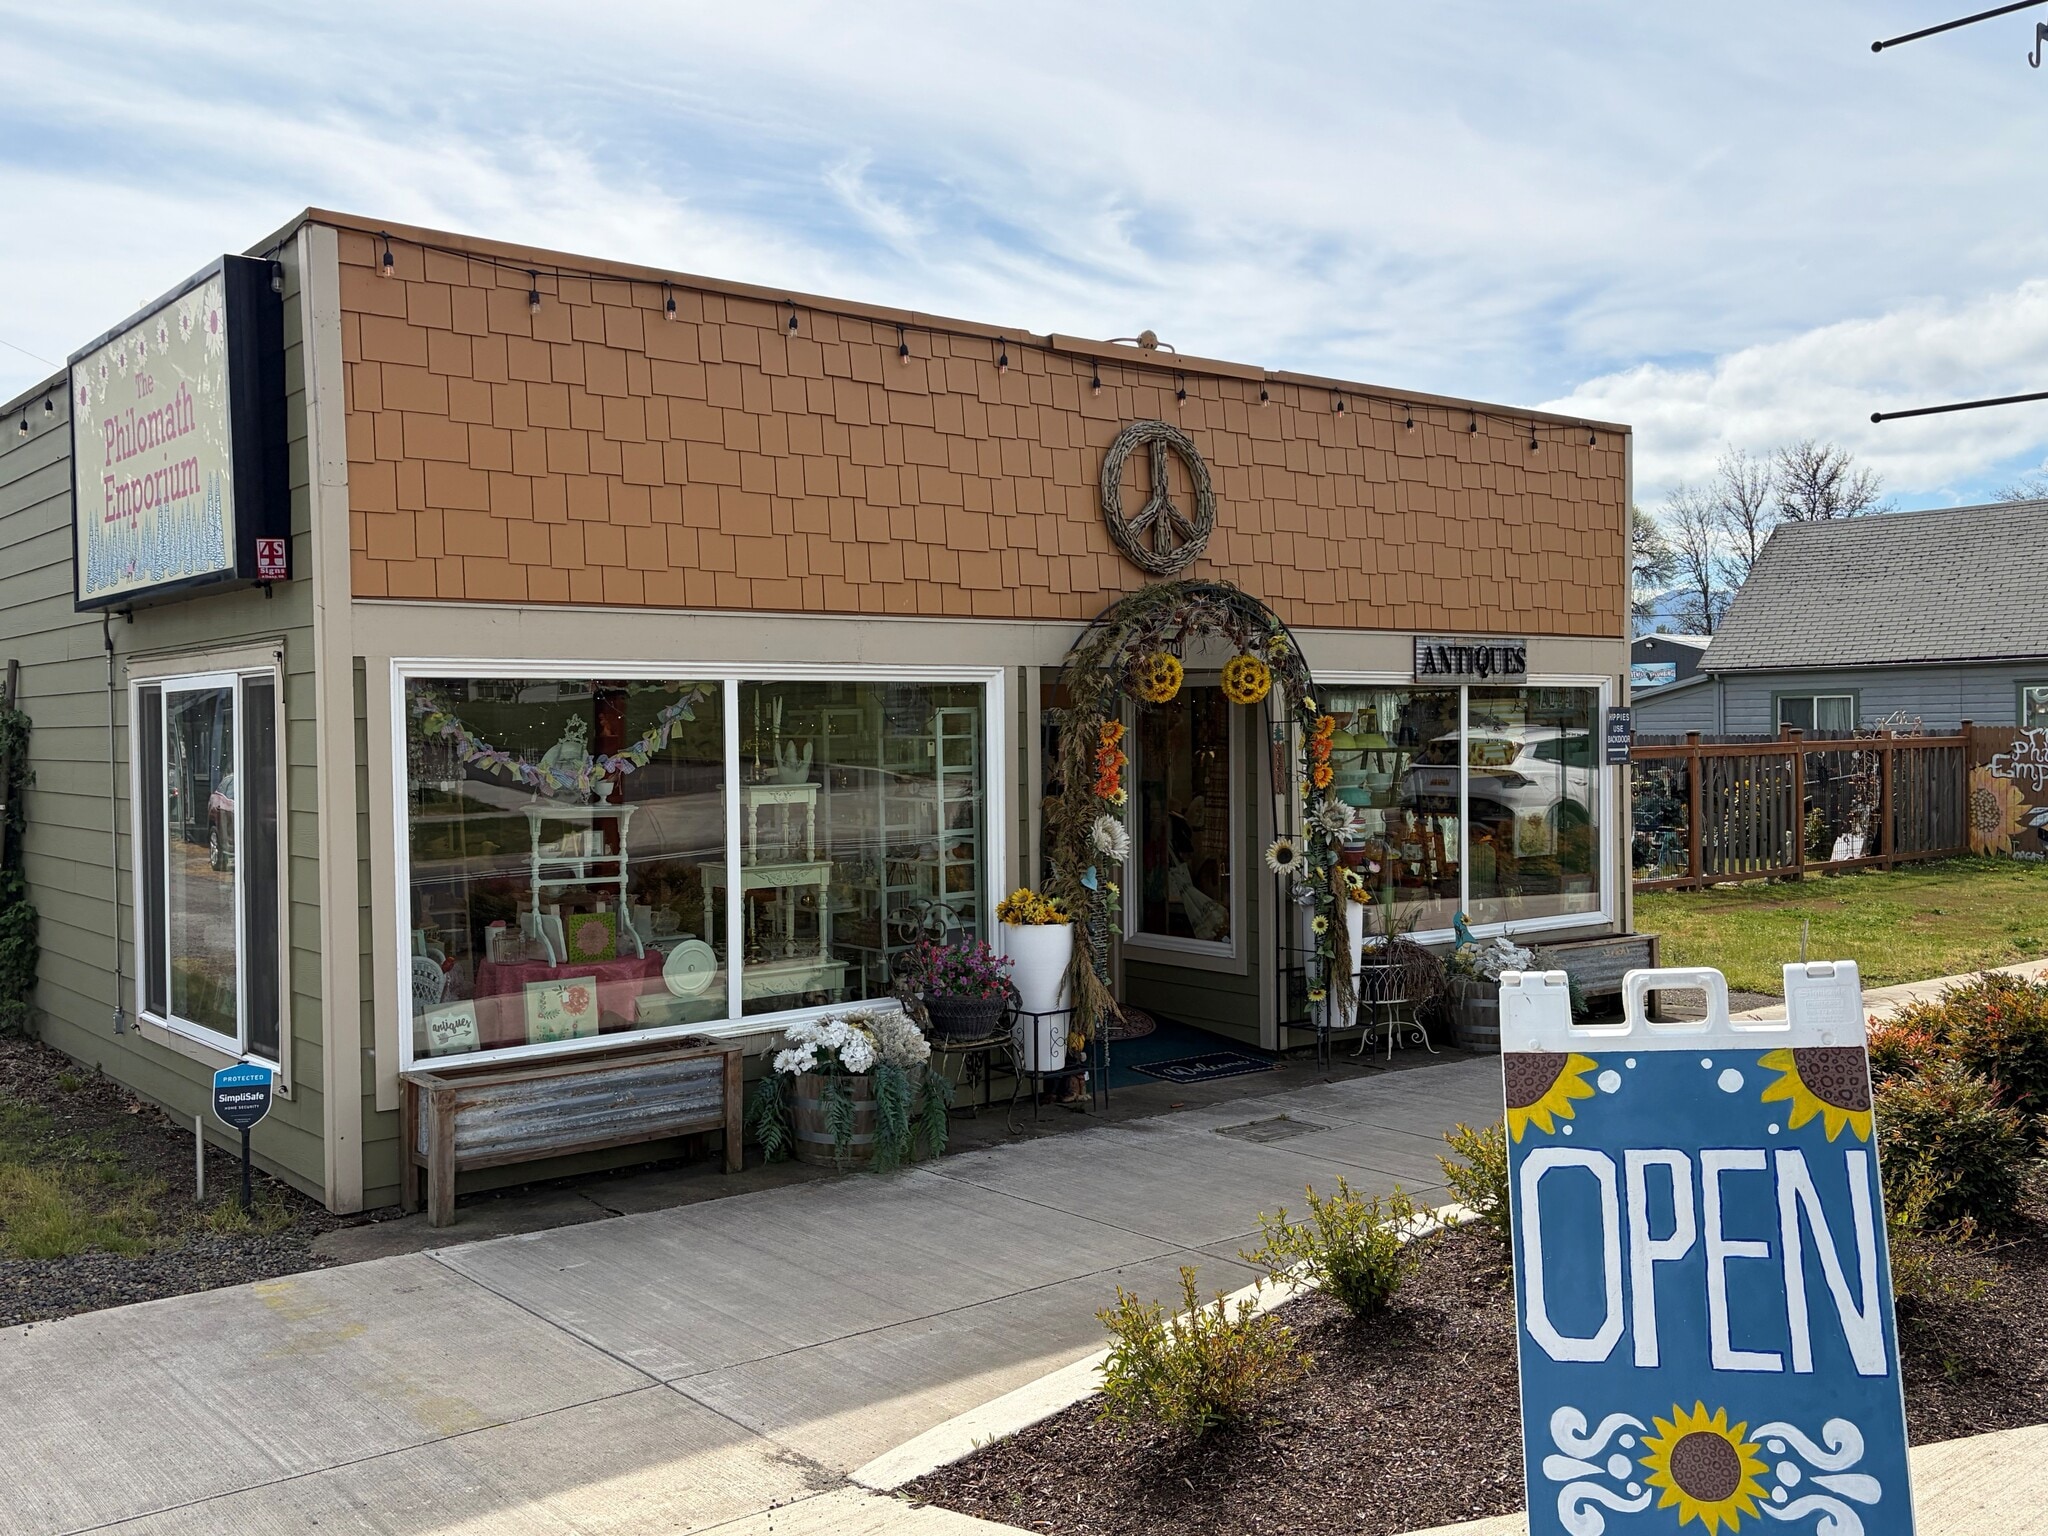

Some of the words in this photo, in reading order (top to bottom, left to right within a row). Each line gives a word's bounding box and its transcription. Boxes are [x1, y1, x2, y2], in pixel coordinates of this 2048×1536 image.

[135, 372, 154, 399] The
[104, 381, 195, 467] Philomath
[104, 452, 200, 529] Emporium
[260, 567, 285, 575] Signs
[1422, 646, 1526, 678] ANTIQUES
[1612, 725, 1624, 733] USE
[432, 1018, 471, 1034] antiques
[219, 1092, 265, 1103] SimpliSafe
[1519, 1147, 1889, 1377] OPEN
